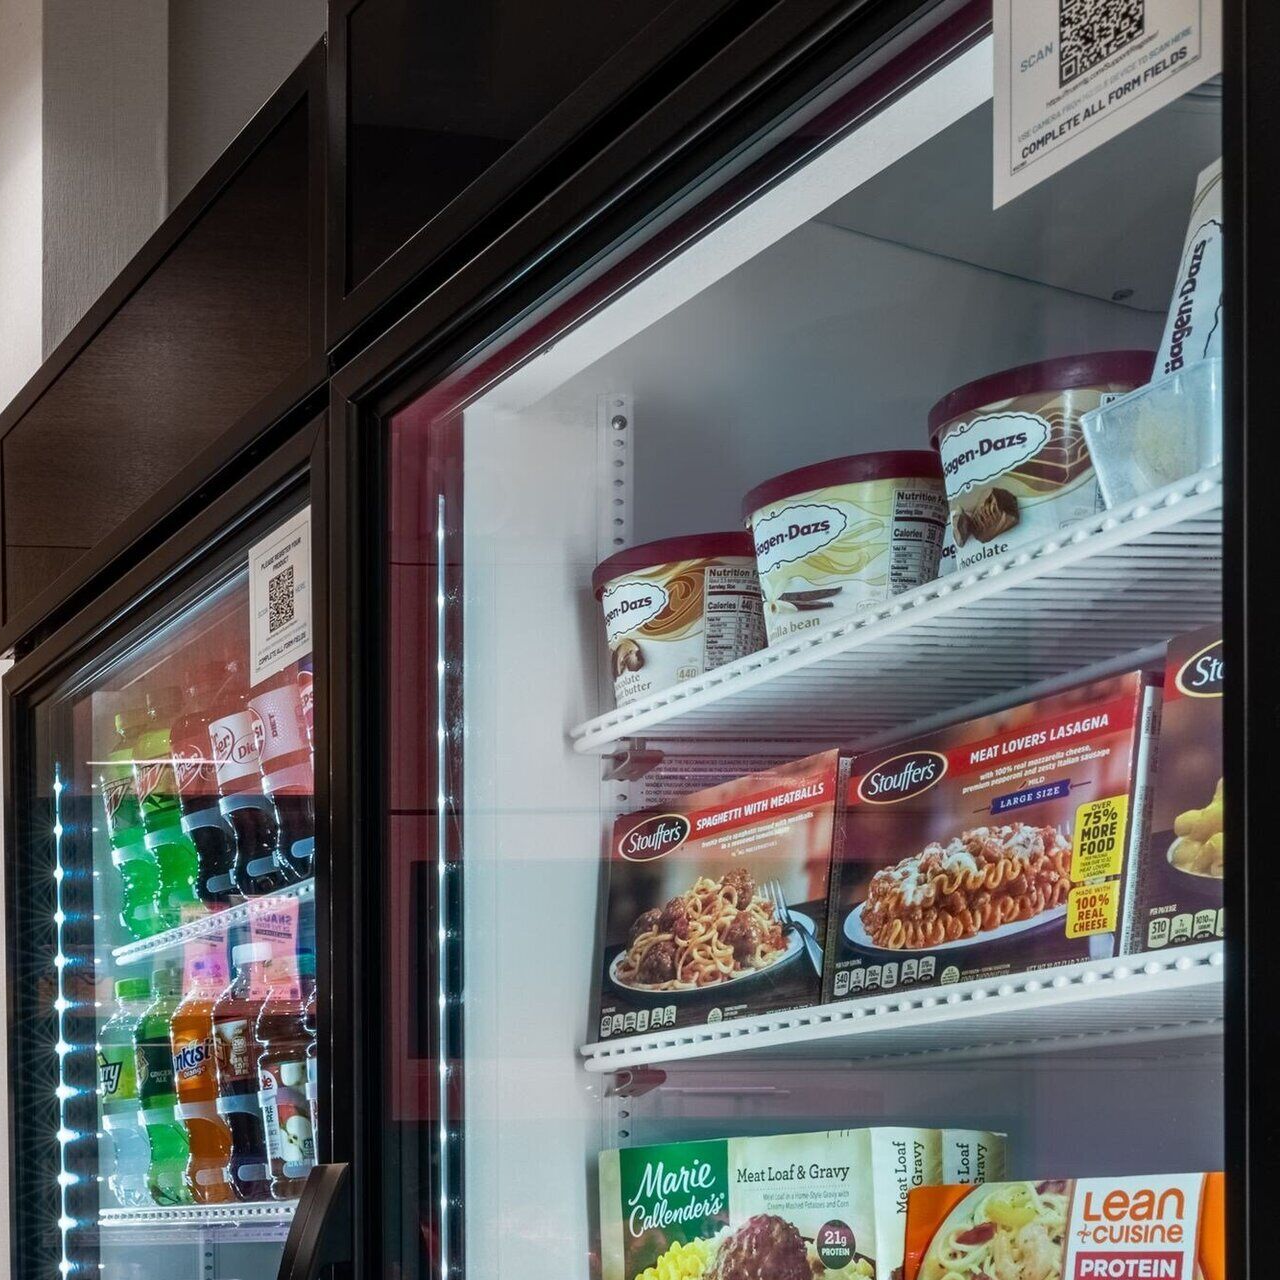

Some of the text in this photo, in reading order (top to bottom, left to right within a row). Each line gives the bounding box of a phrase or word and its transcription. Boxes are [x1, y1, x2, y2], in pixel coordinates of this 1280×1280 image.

[1022, 116, 1081, 160] COMPLETE
[1083, 100, 1106, 121] ALL
[1109, 75, 1142, 106] FORM
[1143, 46, 1188, 86] FIELDS
[269, 713, 278, 738] DIET
[970, 713, 1109, 764] MEAT LOVERS LASAGNA
[867, 759, 936, 796] Stouffer's
[696, 806, 742, 832] SPAGHETTI
[744, 800, 769, 818] WITH
[770, 782, 824, 810] MEATBALLS
[1000, 786, 1060, 809] LARGE SIZE
[1083, 807, 1118, 827] 75%
[627, 820, 681, 854] Stouffer's
[1081, 822, 1117, 843] MORE
[1079, 838, 1115, 857] FOOD
[1076, 894, 1110, 912] 100%
[1077, 906, 1105, 922] REAL
[1072, 918, 1108, 934] CHEESE
[150, 1069, 172, 1079] GINGER
[155, 1076, 168, 1084] ALE
[183, 1065, 205, 1079] Orange
[628, 1160, 716, 1205] Marie
[737, 1164, 850, 1183] Meat Loaf & Gravy
[1083, 1189, 1184, 1222] Lean
[629, 1194, 723, 1238] Callender's
[821, 1246, 850, 1257] PROTEIN
[1080, 1259, 1176, 1278] PROTEIN
